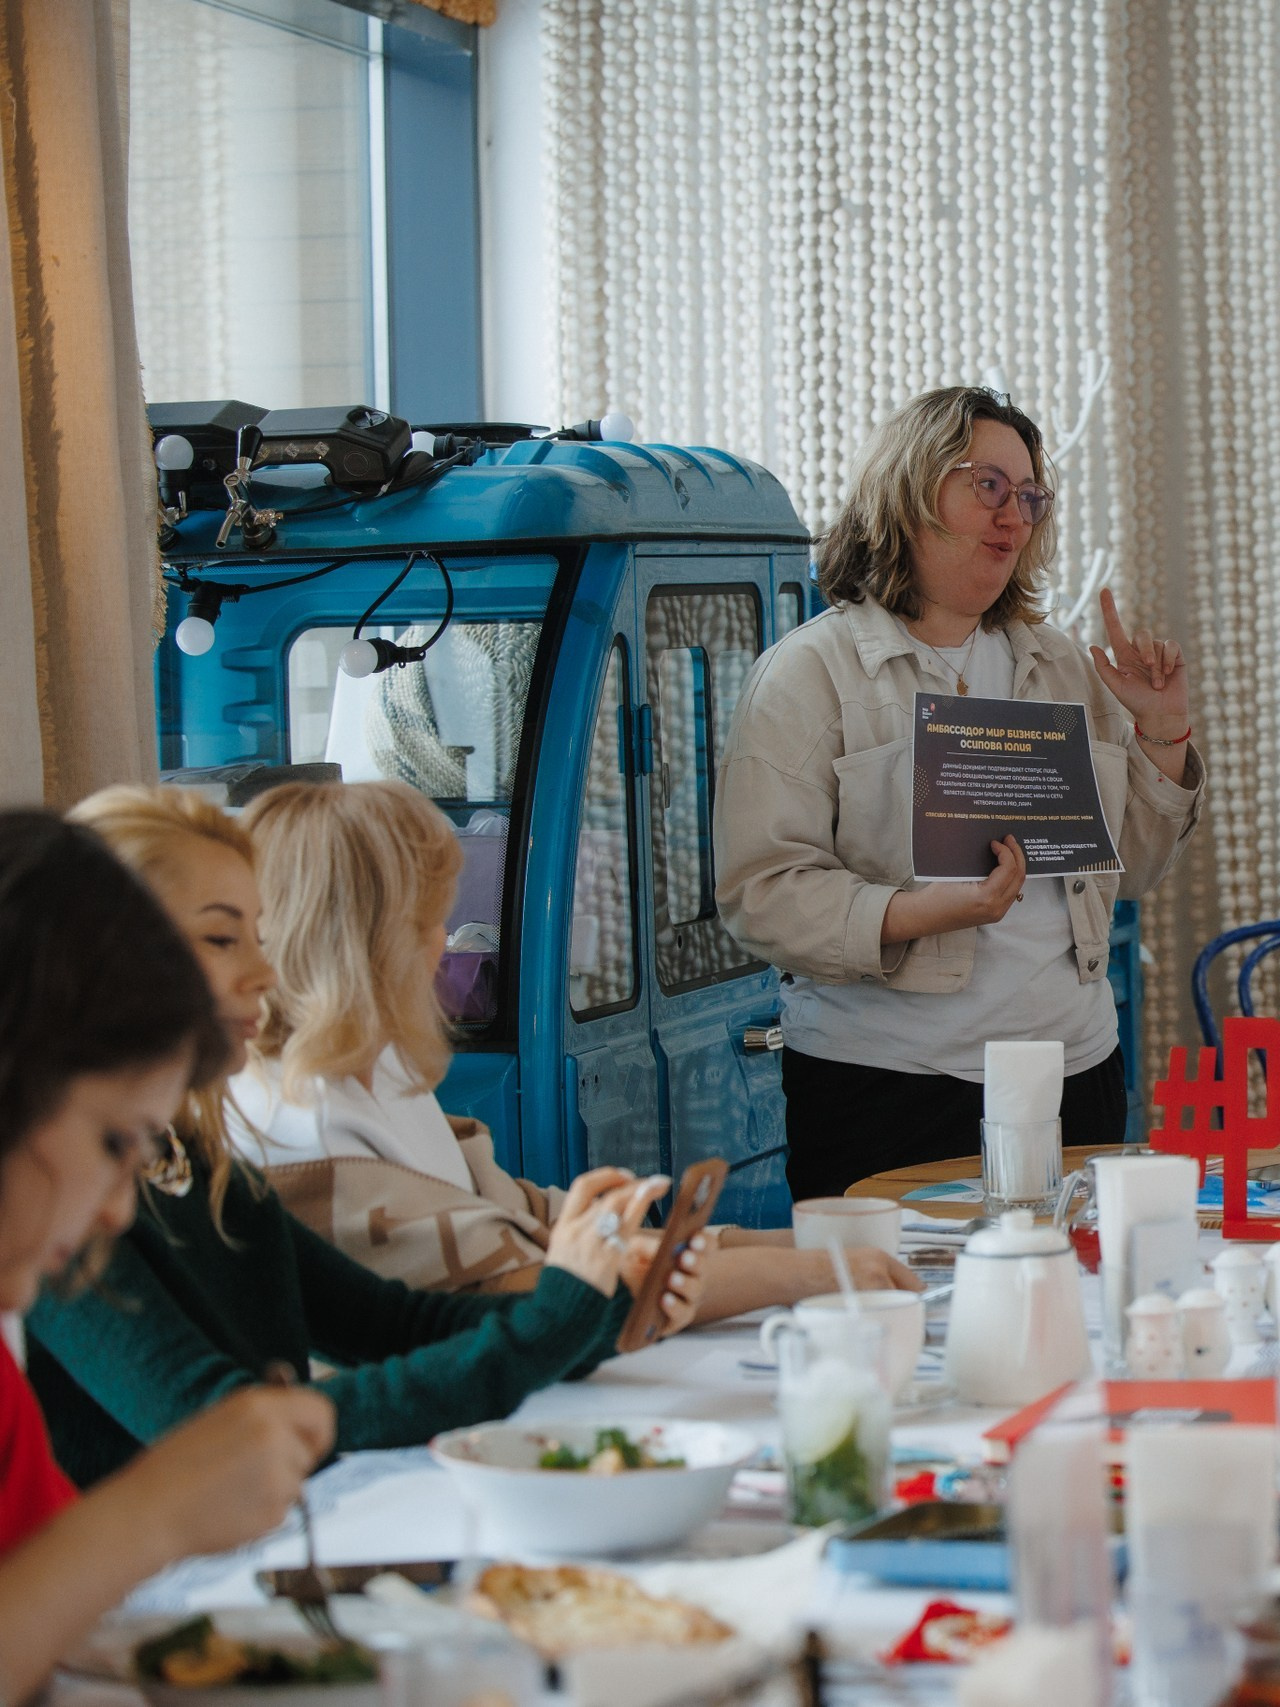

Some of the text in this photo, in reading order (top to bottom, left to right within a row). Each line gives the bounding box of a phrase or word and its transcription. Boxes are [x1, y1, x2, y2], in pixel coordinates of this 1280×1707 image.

[927, 723, 1066, 741] АМБАССАДОР МИР БИЗНЕС МАМ
[960, 739, 1032, 752] ОСИПОВА ЮЛИЯ
